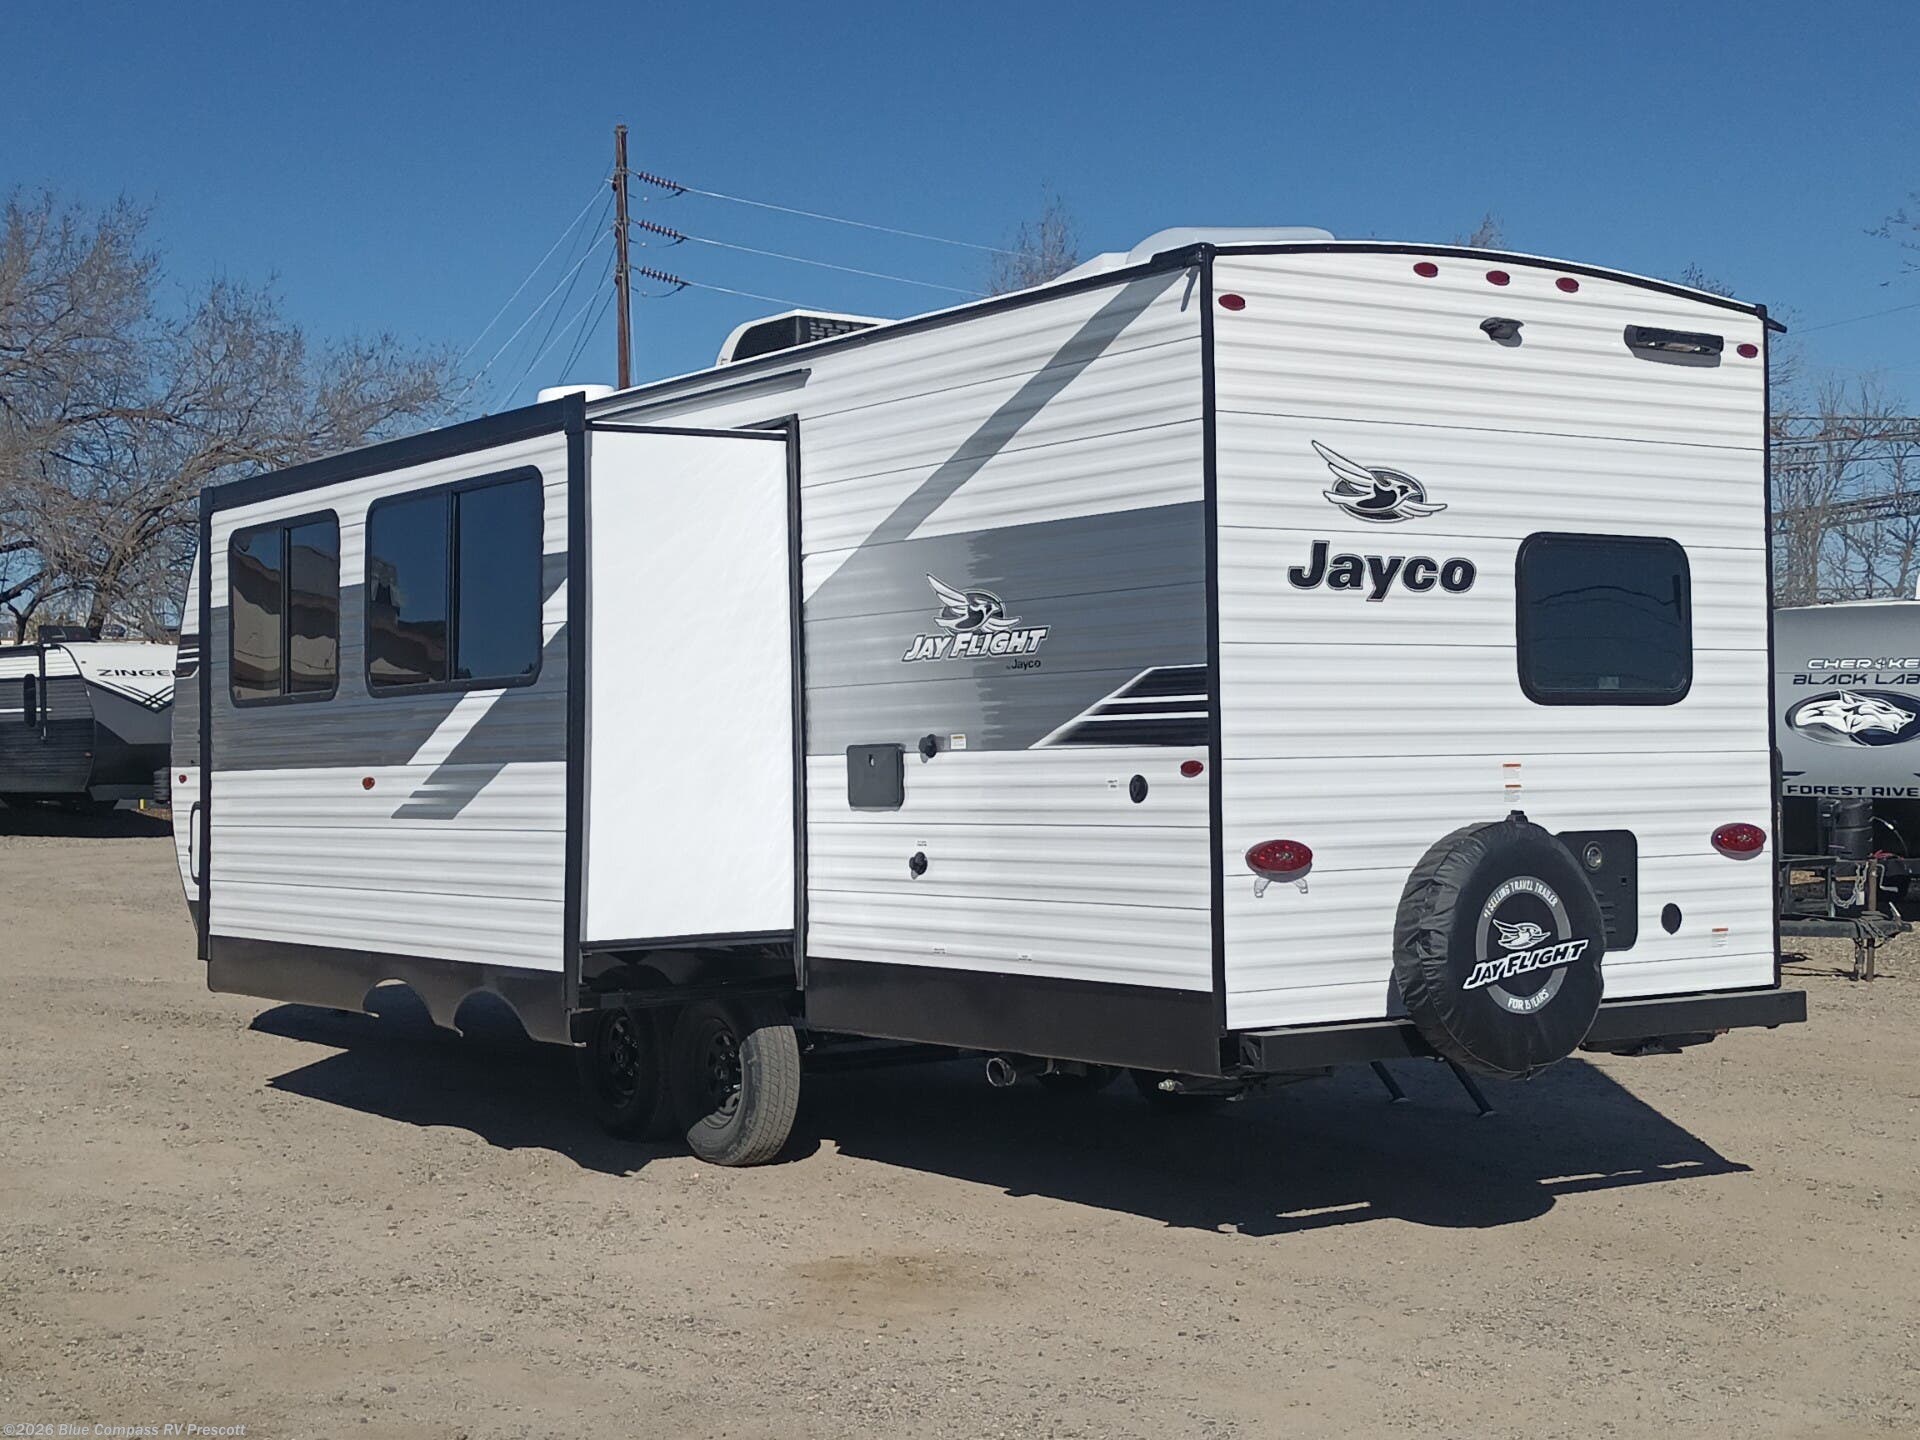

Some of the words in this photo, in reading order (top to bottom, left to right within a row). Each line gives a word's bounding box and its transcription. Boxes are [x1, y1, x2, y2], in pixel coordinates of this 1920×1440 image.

[1287, 539, 1477, 602] Jayco
[902, 632, 953, 663] JAY
[948, 625, 1051, 660] FLIGHT
[1011, 658, 1041, 670] Jayco
[1793, 673, 1868, 685] BLACK
[1875, 673, 1920, 685] LAB
[1787, 784, 1866, 796] FOREST
[1872, 786, 1919, 797] RIVE
[1487, 884, 1510, 912] SELLING
[1510, 879, 1533, 893] TRAVEL
[1534, 882, 1558, 907] TRAILER
[1462, 958, 1506, 990] JAY
[1503, 939, 1589, 978] FLIGHT
[1507, 997, 1524, 1010] FOR
[1530, 988, 1549, 1008] YEARS
